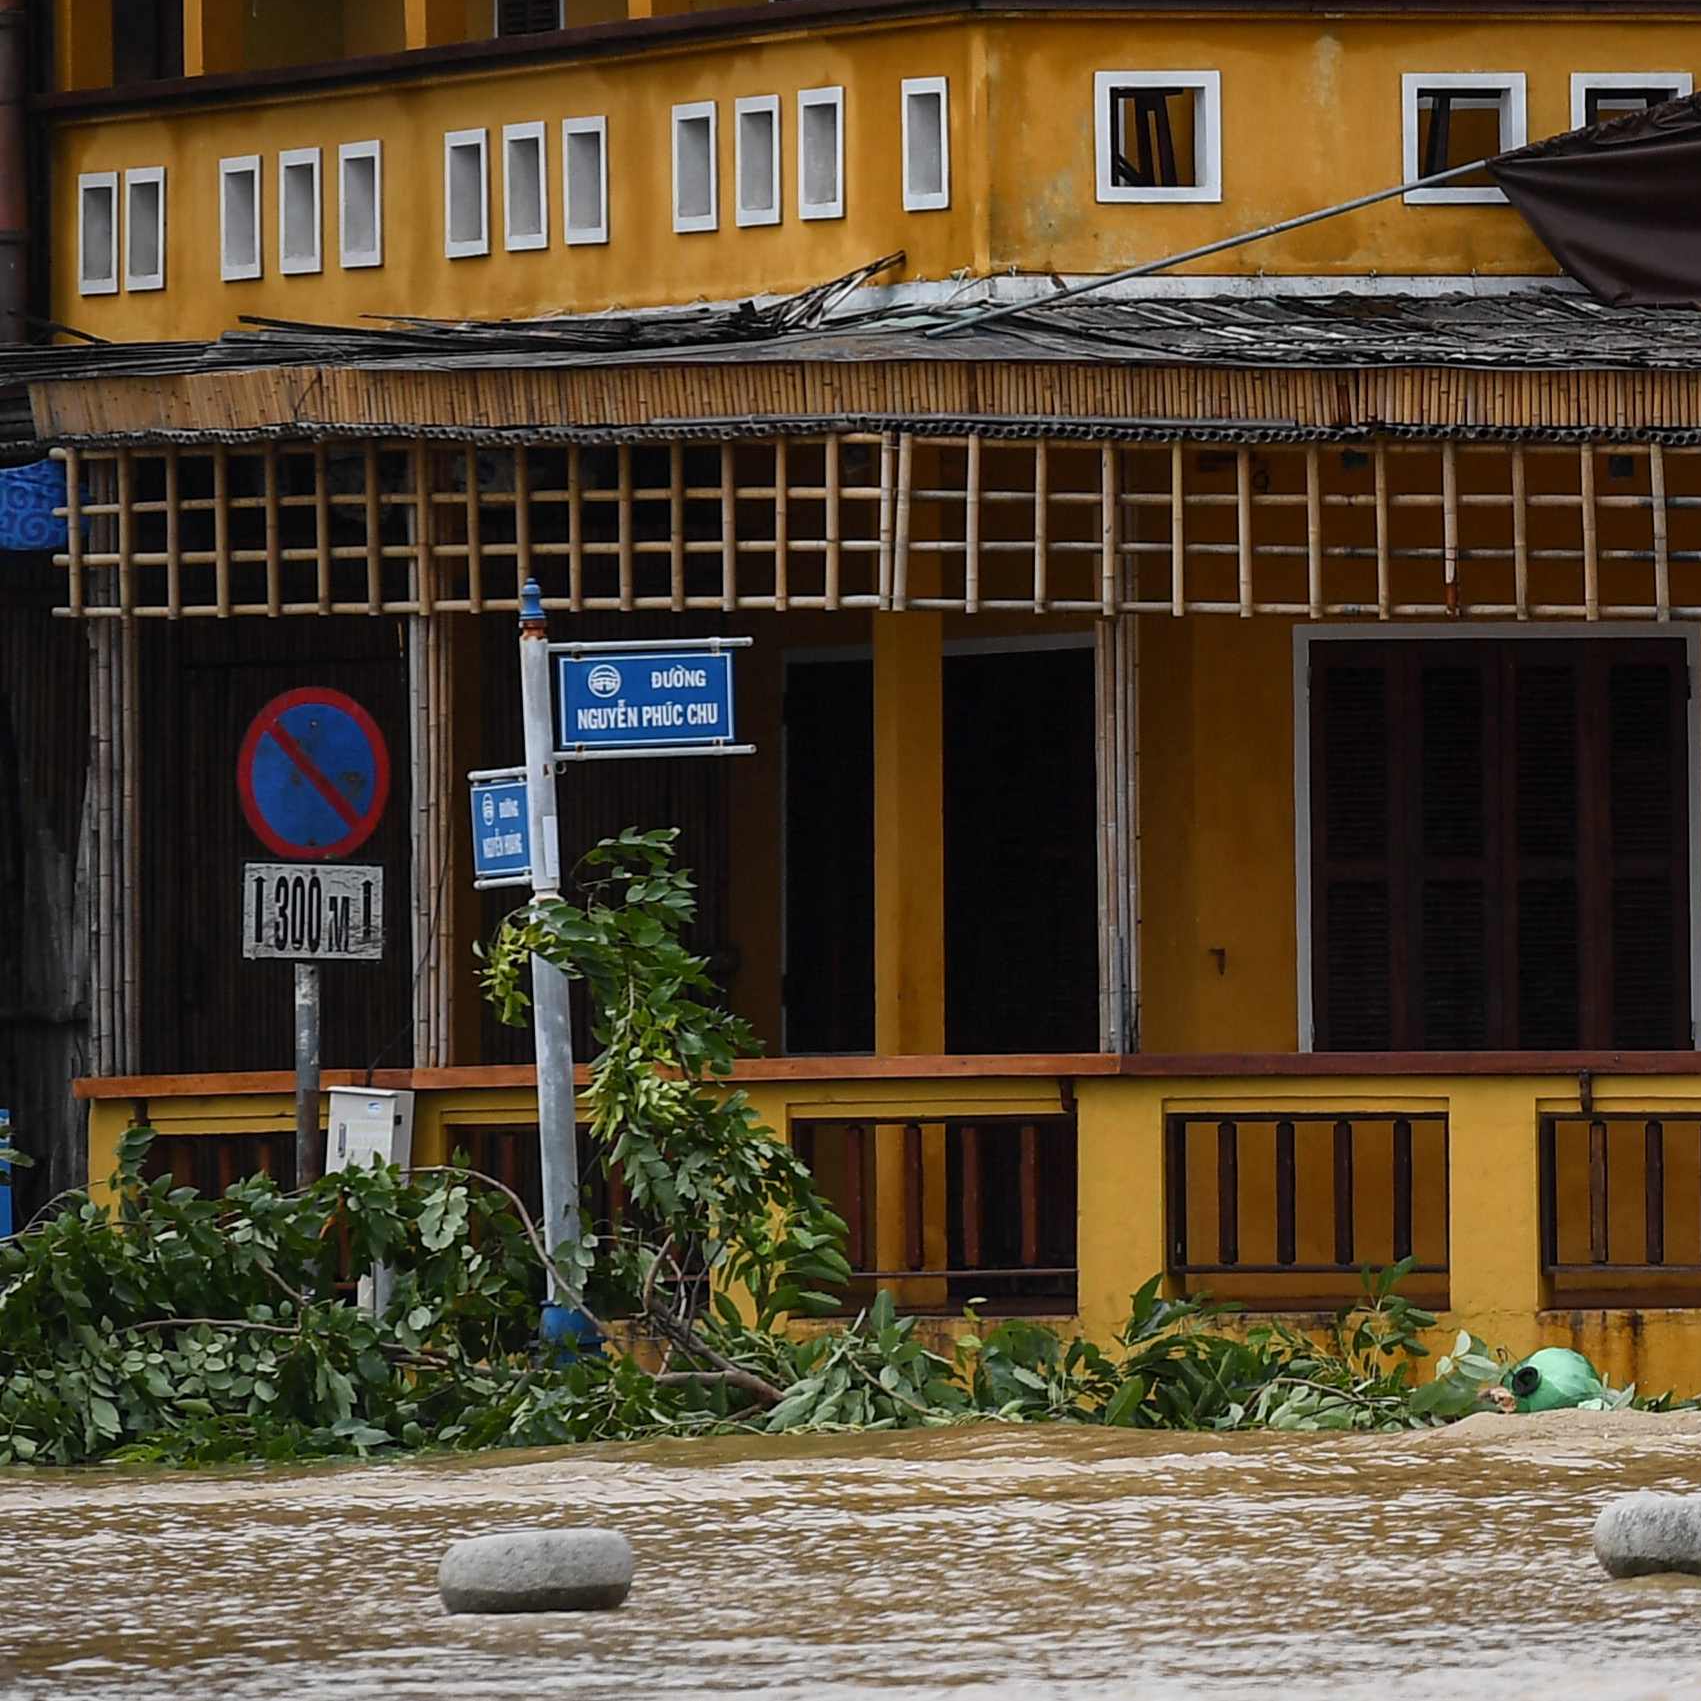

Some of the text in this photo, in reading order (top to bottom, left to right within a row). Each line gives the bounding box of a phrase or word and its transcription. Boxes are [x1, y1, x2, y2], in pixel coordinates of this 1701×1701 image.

[650, 664, 707, 689] ĐƯỜNG
[577, 699, 719, 730] NGUYỄN PHÚC CHU
[274, 875, 322, 953] 300
